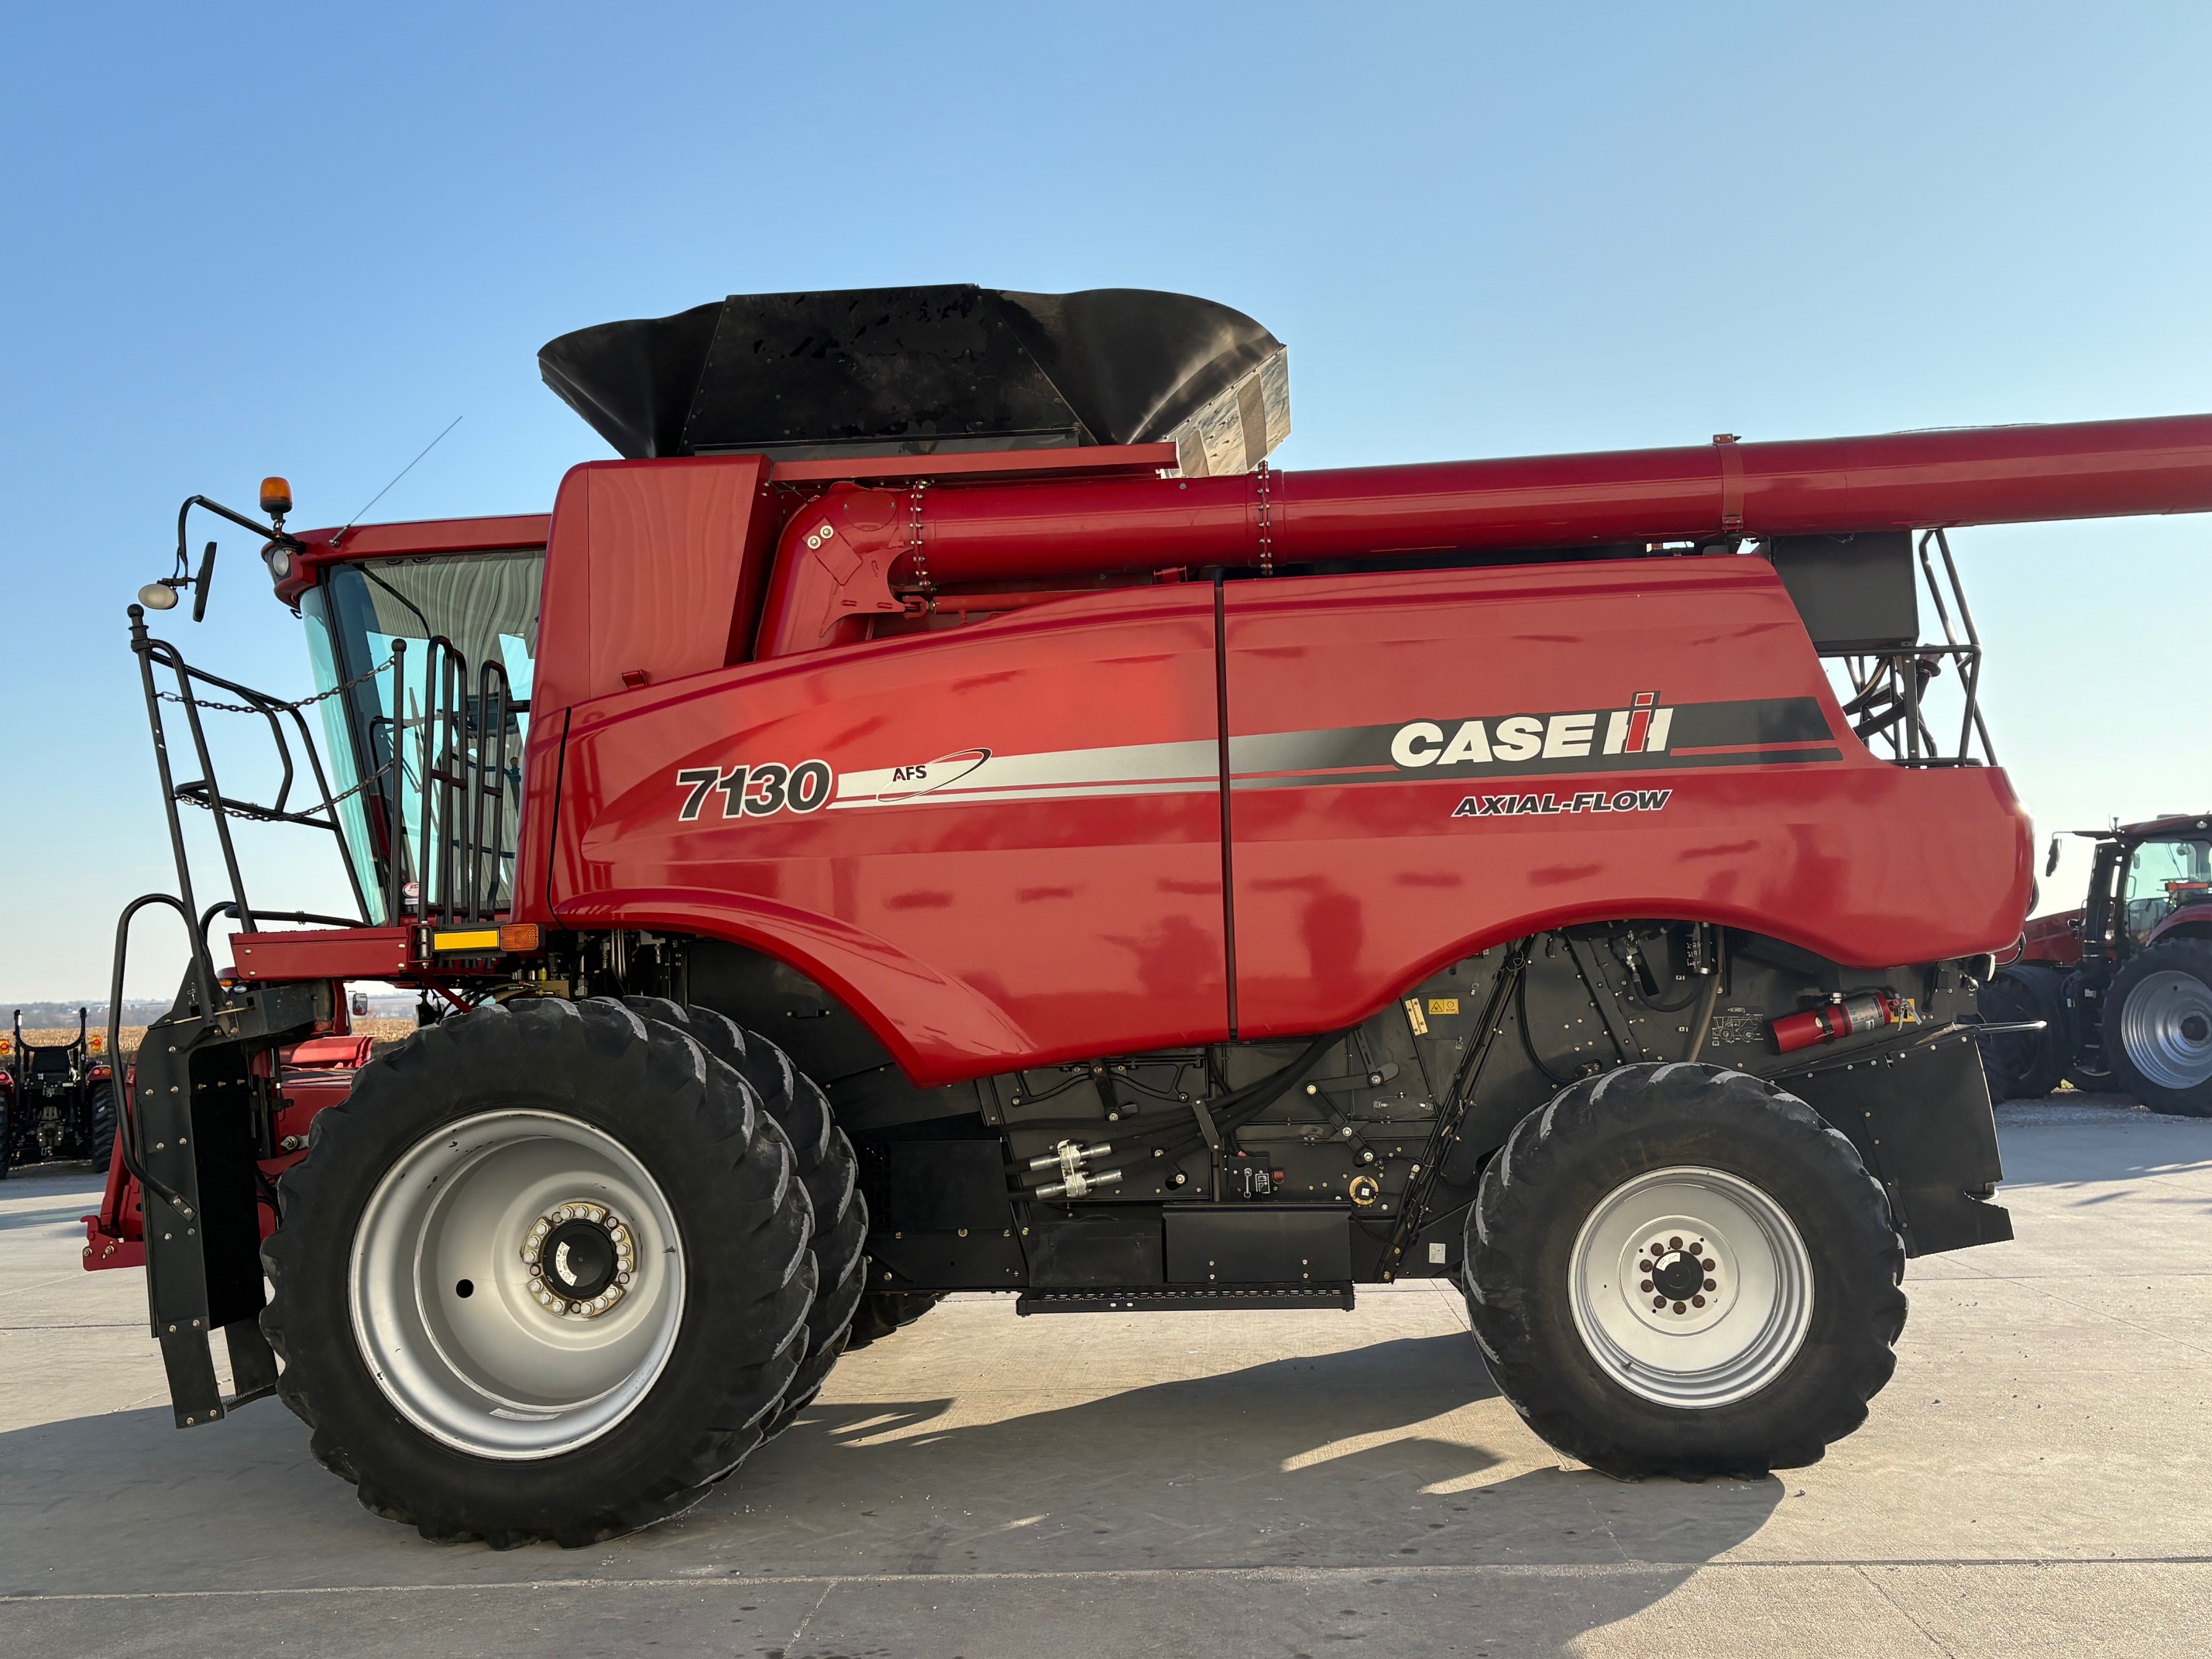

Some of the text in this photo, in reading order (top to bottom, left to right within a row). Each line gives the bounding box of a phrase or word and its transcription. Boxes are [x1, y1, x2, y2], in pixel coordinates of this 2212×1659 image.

[1391, 713, 1597, 768] CASE
[676, 759, 833, 822] 7130
[892, 764, 927, 782] AFS
[1451, 789, 1673, 818] AXIAL-FLOW
